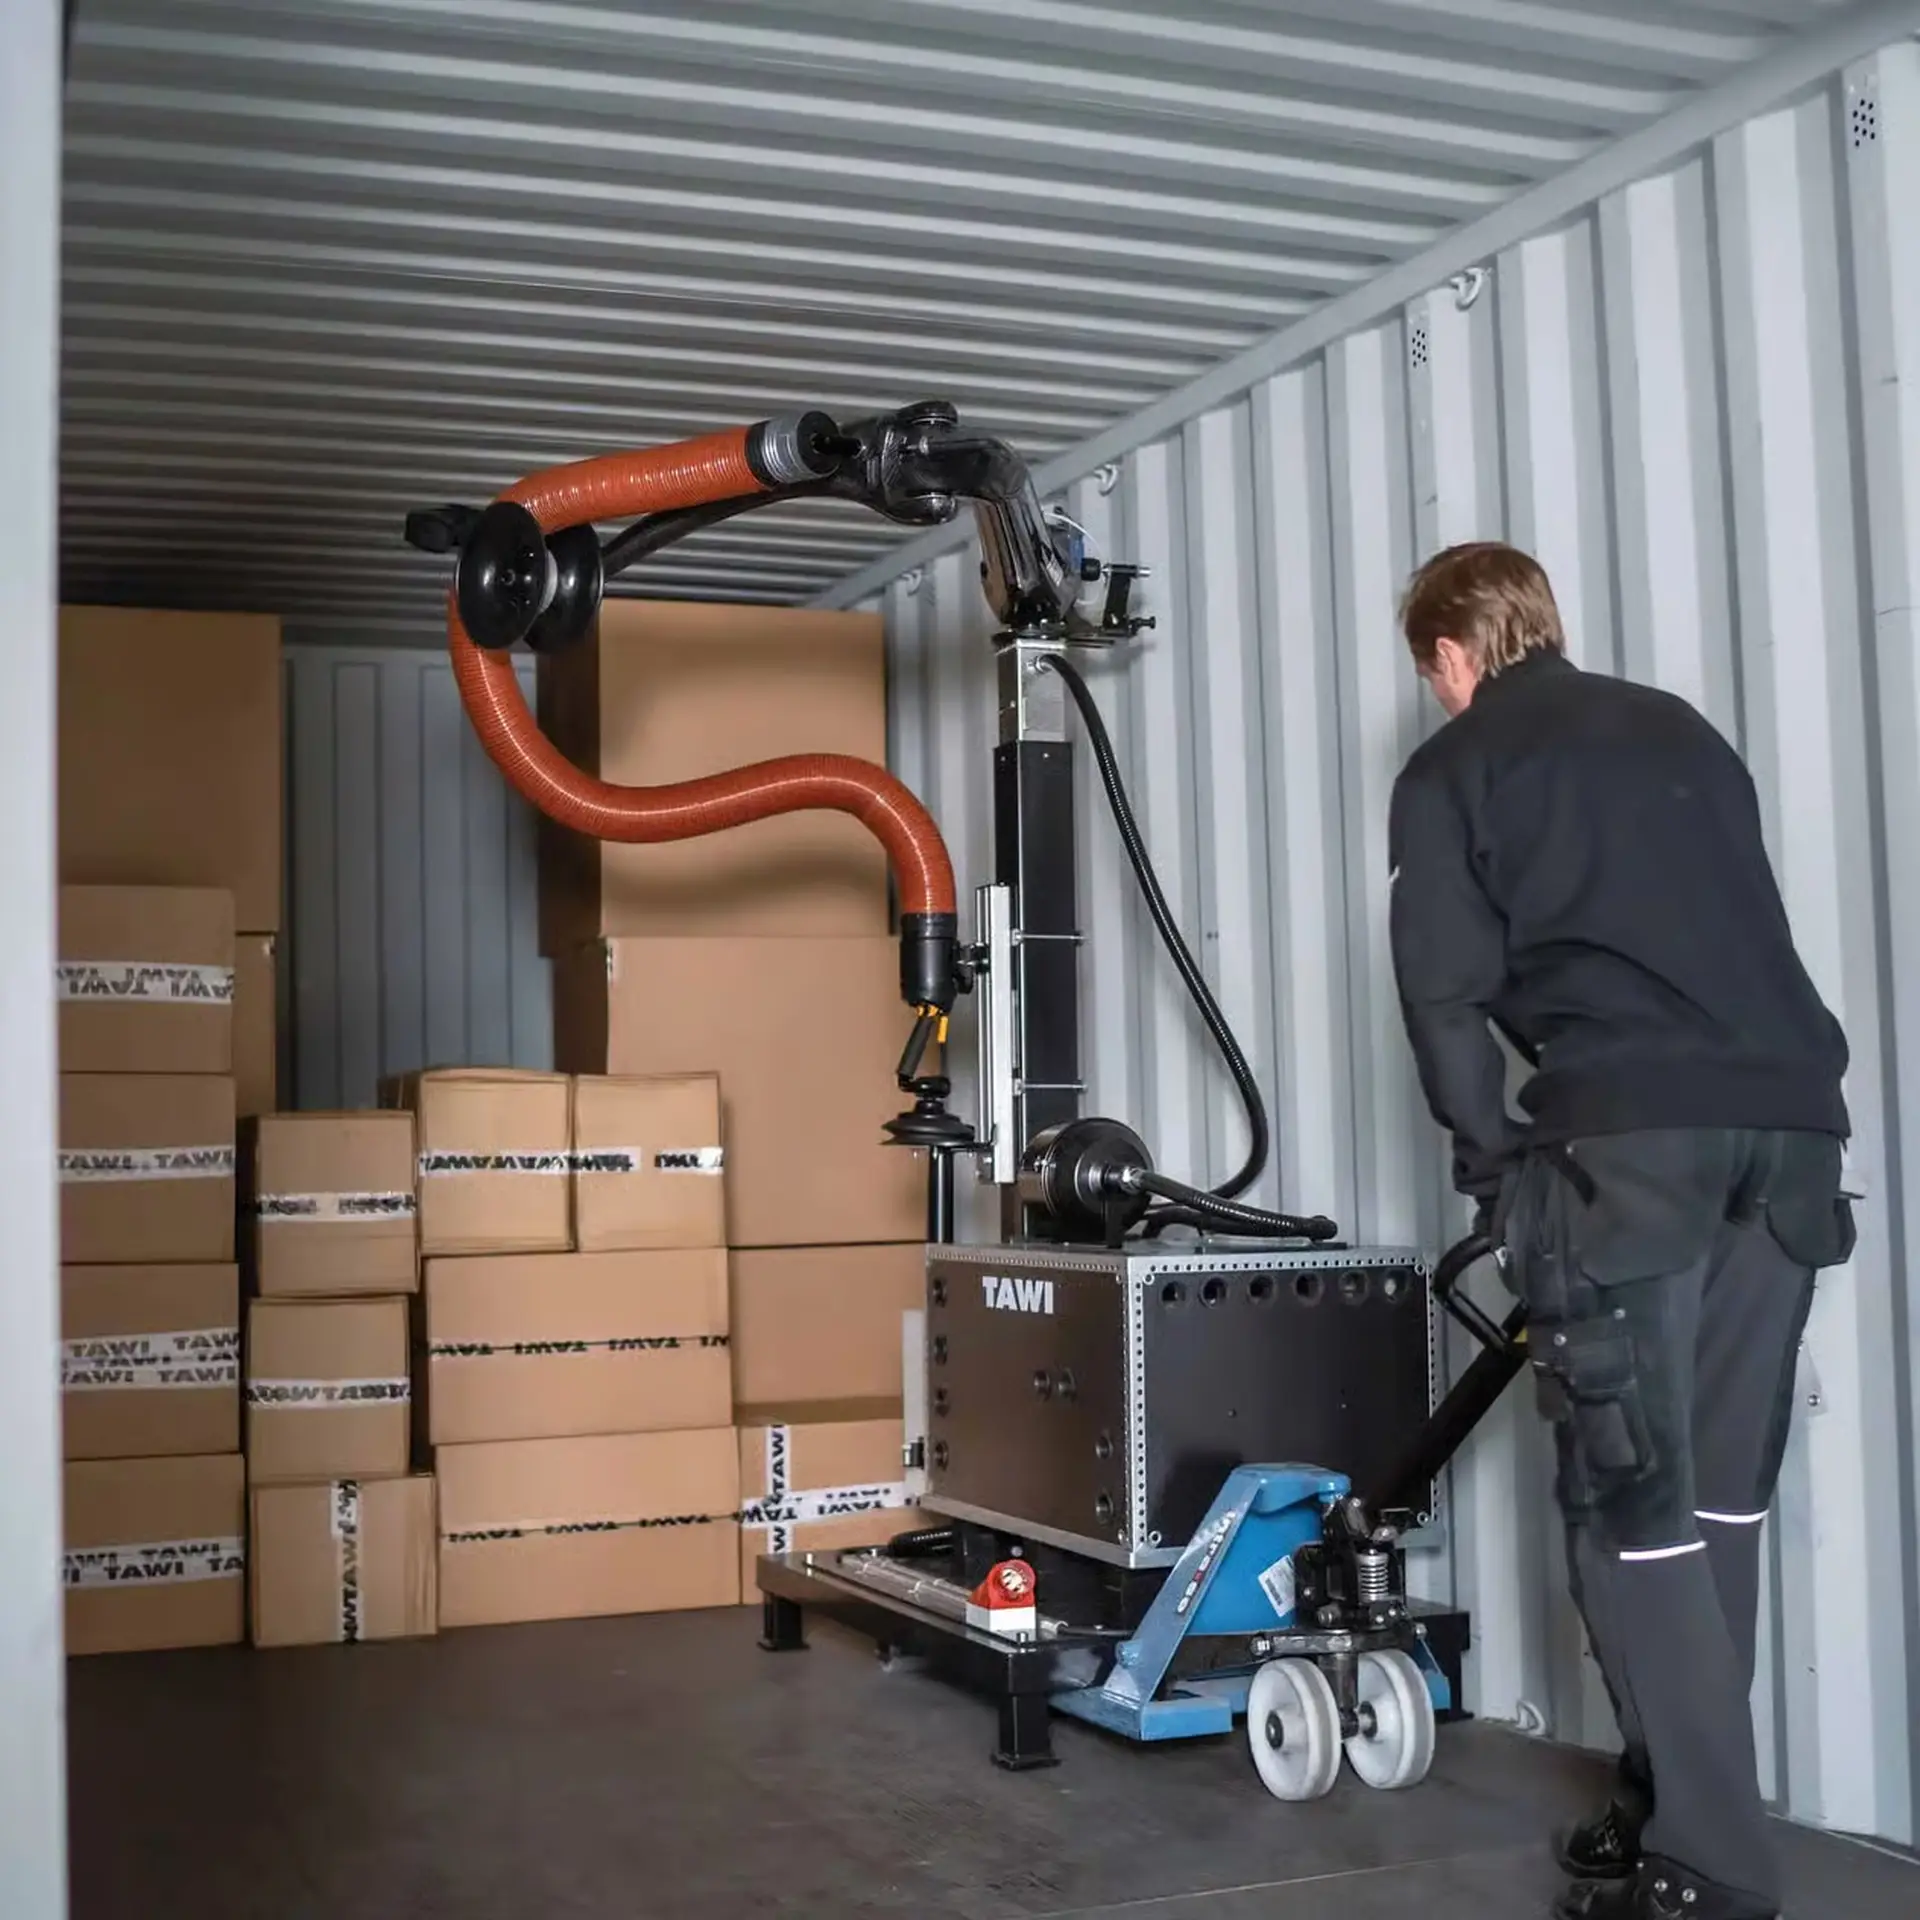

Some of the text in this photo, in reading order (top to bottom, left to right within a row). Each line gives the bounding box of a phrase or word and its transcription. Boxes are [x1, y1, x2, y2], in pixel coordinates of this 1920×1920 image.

[982, 1275, 1053, 1314] TAWI
[71, 1333, 240, 1357] TAWI TAW
[157, 1368, 236, 1383] TAWI
[104, 1561, 184, 1580] TAWI
